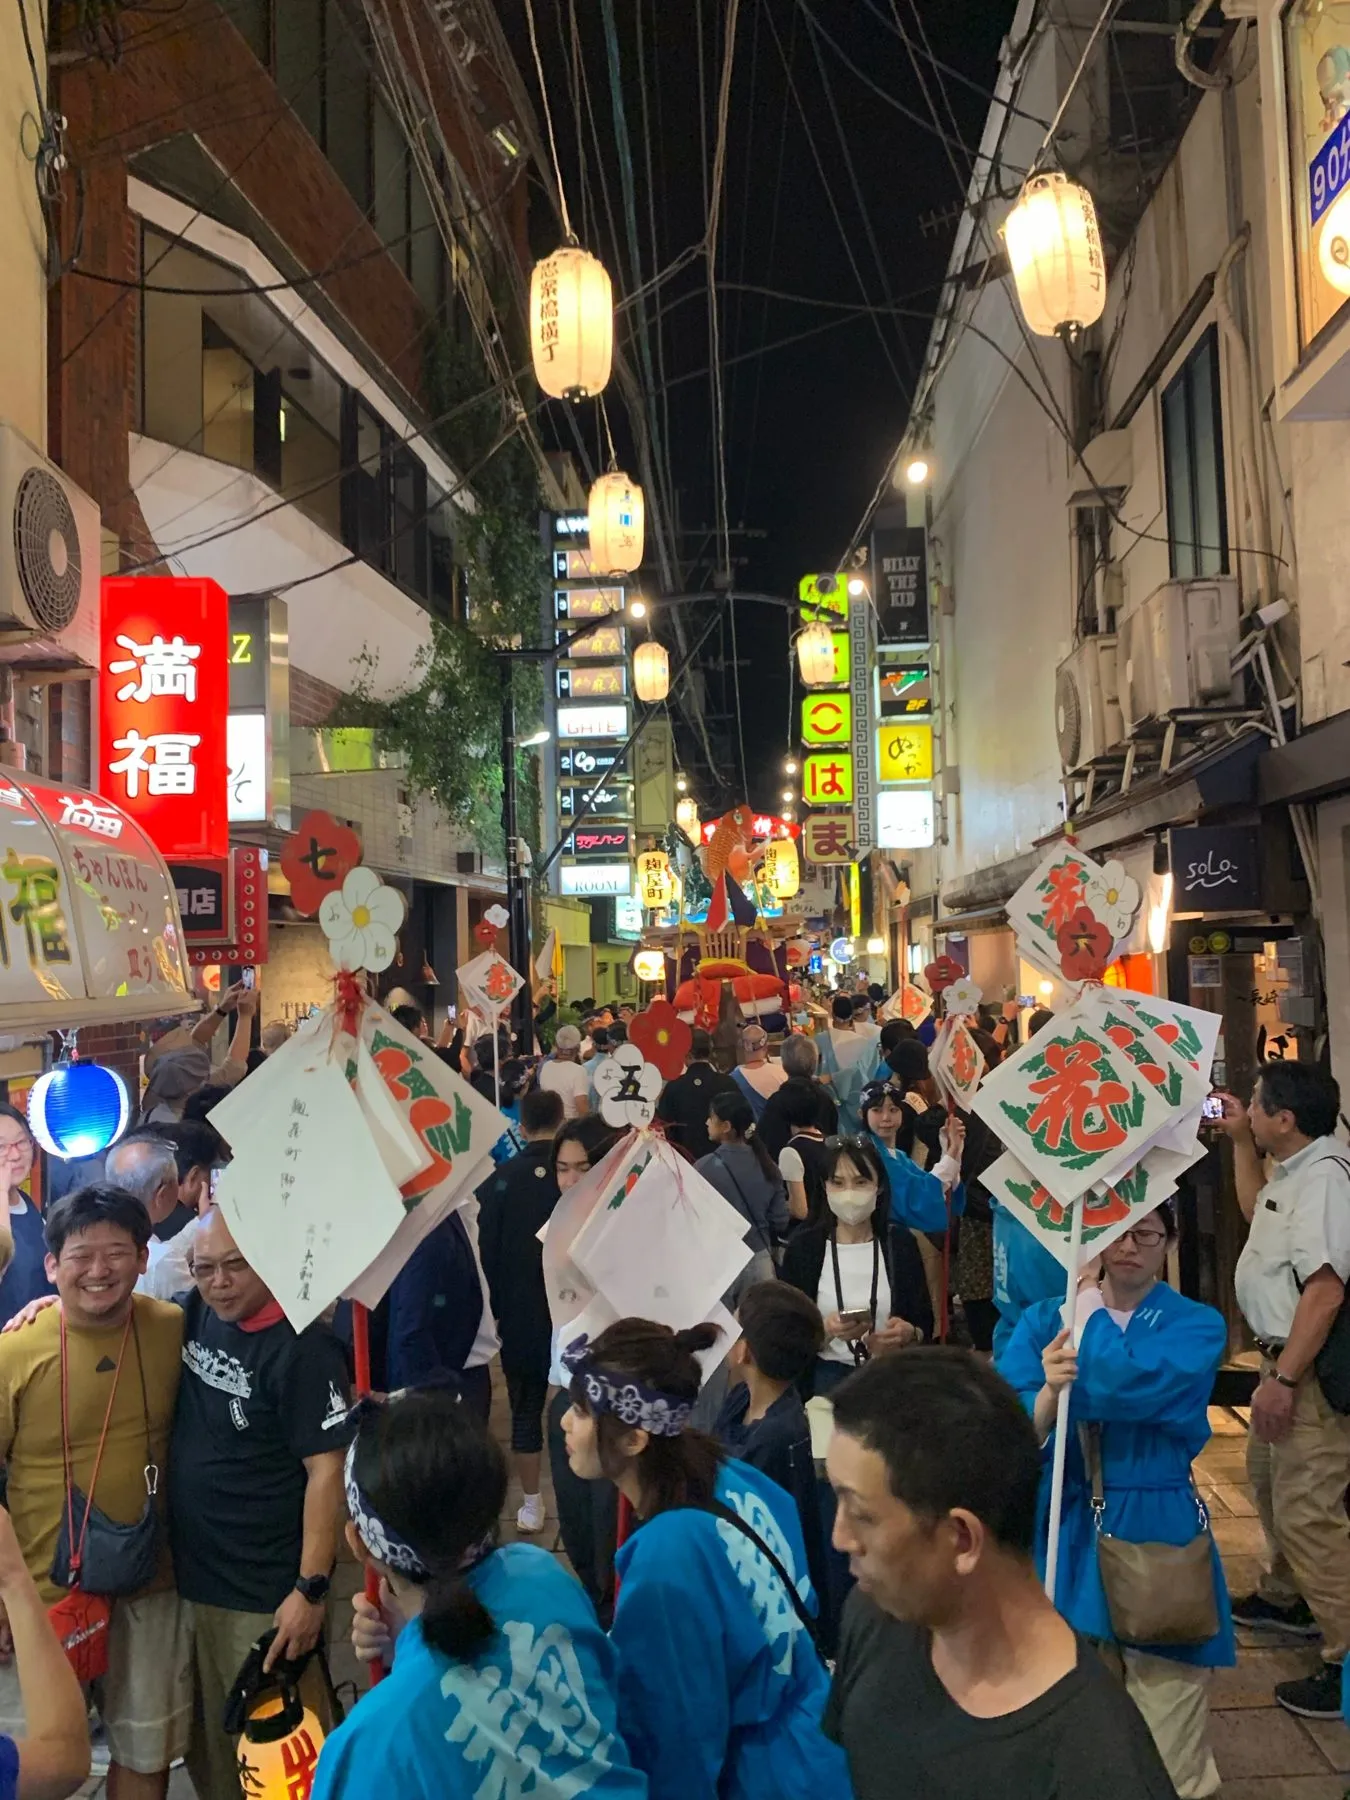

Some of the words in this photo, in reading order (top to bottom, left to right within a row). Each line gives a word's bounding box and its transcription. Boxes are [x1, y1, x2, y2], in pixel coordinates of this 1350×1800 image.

[882, 556, 920, 573] BILLY
[888, 574, 918, 590] THE
[890, 591, 916, 607] KID
[228, 634, 251, 664] Z
[905, 698, 928, 712] 2F
[109, 635, 201, 798] 満福
[561, 756, 570, 769] 2
[562, 796, 571, 808] 2
[304, 837, 337, 880] 七
[611, 1065, 647, 1103] 五
[1028, 1043, 1131, 1153] 花
